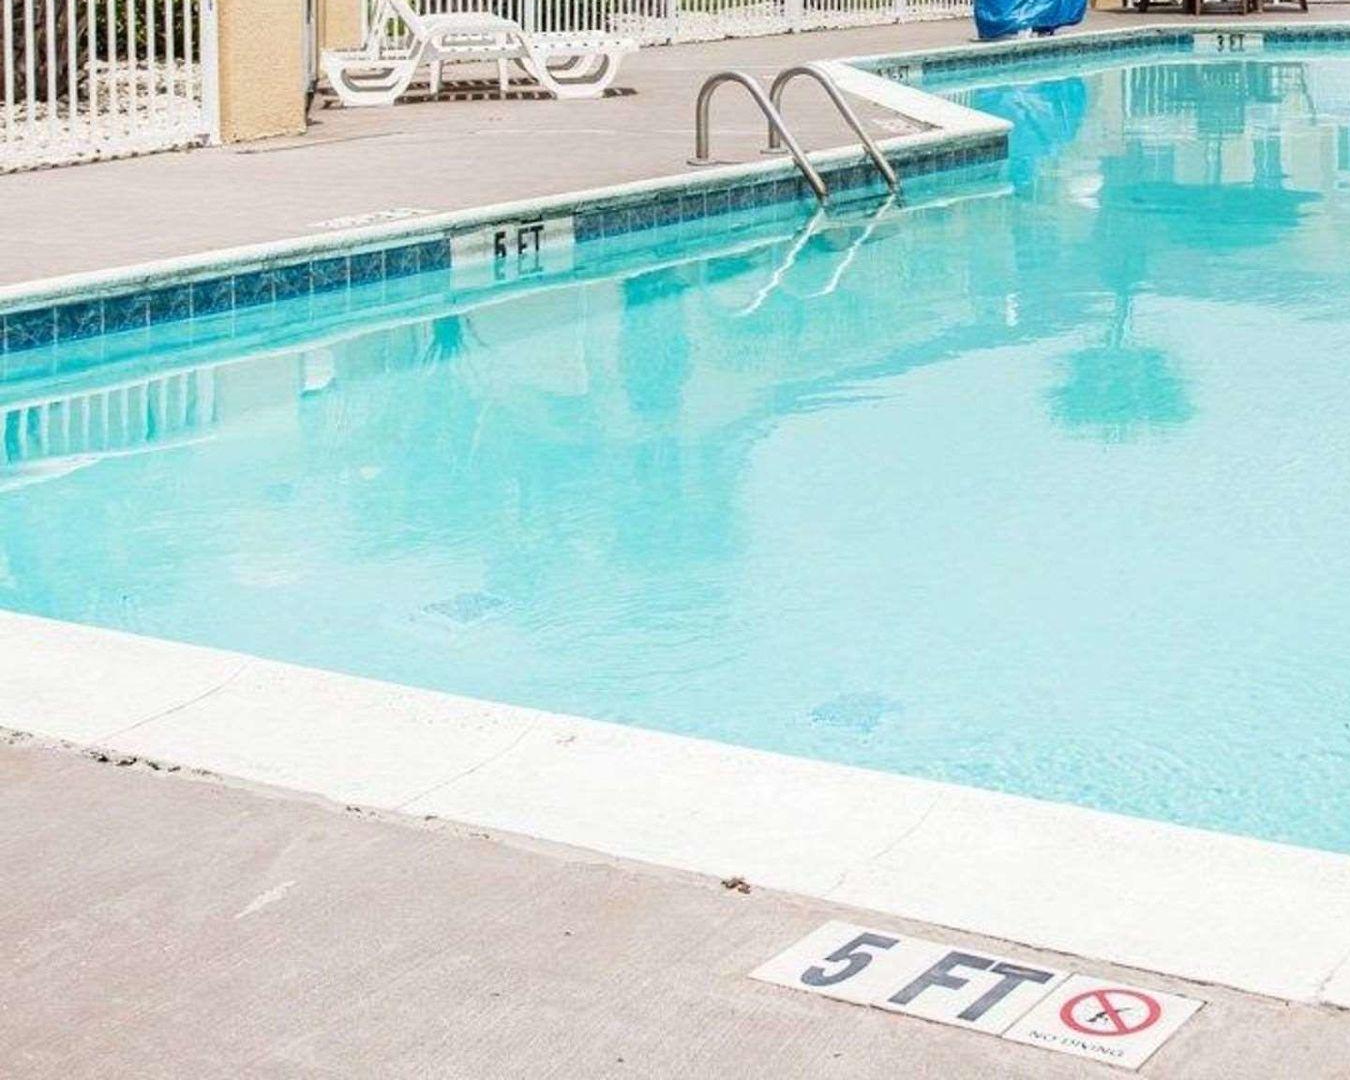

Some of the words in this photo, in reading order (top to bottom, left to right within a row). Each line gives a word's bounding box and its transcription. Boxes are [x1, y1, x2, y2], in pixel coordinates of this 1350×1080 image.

[517, 224, 544, 254] FT
[801, 932, 900, 986] 5
[887, 950, 1054, 1021] FT
